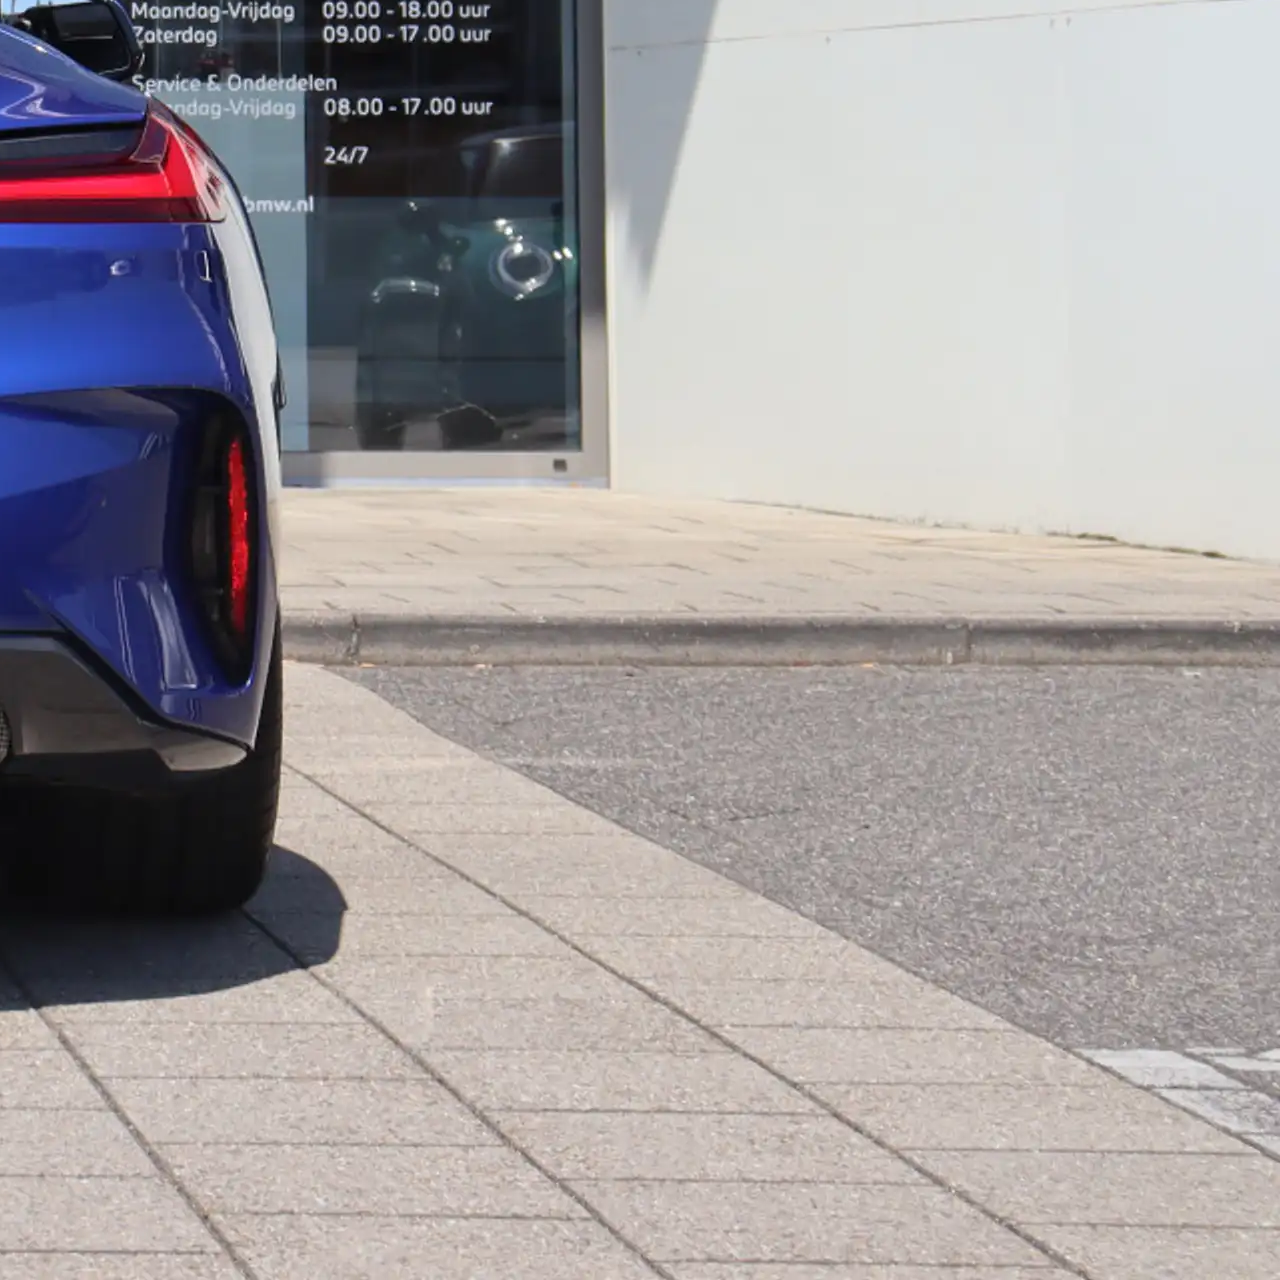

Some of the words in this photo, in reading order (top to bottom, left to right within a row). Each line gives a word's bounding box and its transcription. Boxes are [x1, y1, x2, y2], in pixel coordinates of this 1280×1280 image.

[131, 1, 295, 22] Maandag-Vrijdag
[323, 1, 380, 19] 09.00
[400, 0, 453, 18] 18.00
[460, 5, 490, 18] uur
[132, 26, 218, 47] Zaterdag
[323, 25, 380, 43] 09.00
[460, 29, 491, 42] uur
[131, 73, 202, 92] Service
[207, 74, 222, 92] &
[227, 73, 338, 92] Onderdelen
[170, 99, 296, 118] ndag-Vrijdag
[324, 98, 383, 115] 08.00
[462, 102, 493, 115] uur
[325, 147, 368, 164] 24/7
